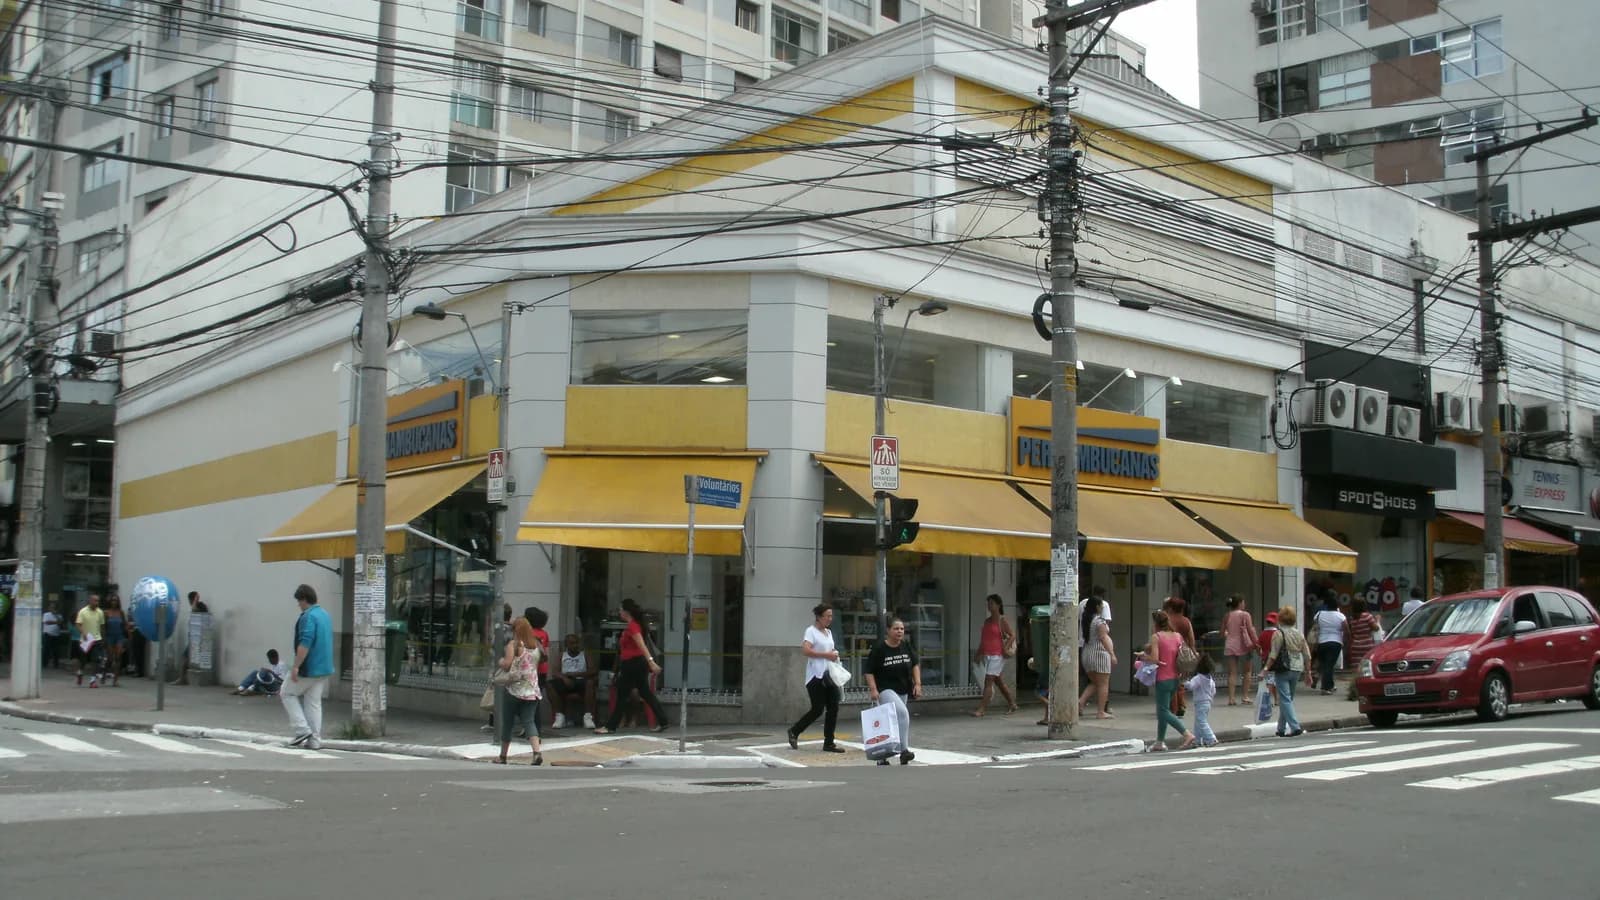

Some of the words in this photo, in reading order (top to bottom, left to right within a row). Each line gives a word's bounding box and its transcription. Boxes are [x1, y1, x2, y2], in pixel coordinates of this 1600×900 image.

[1017, 436, 1159, 480] PERMBUCANAS
[1533, 470, 1560, 484] TENNIS
[1535, 487, 1565, 501] EXPRESS
